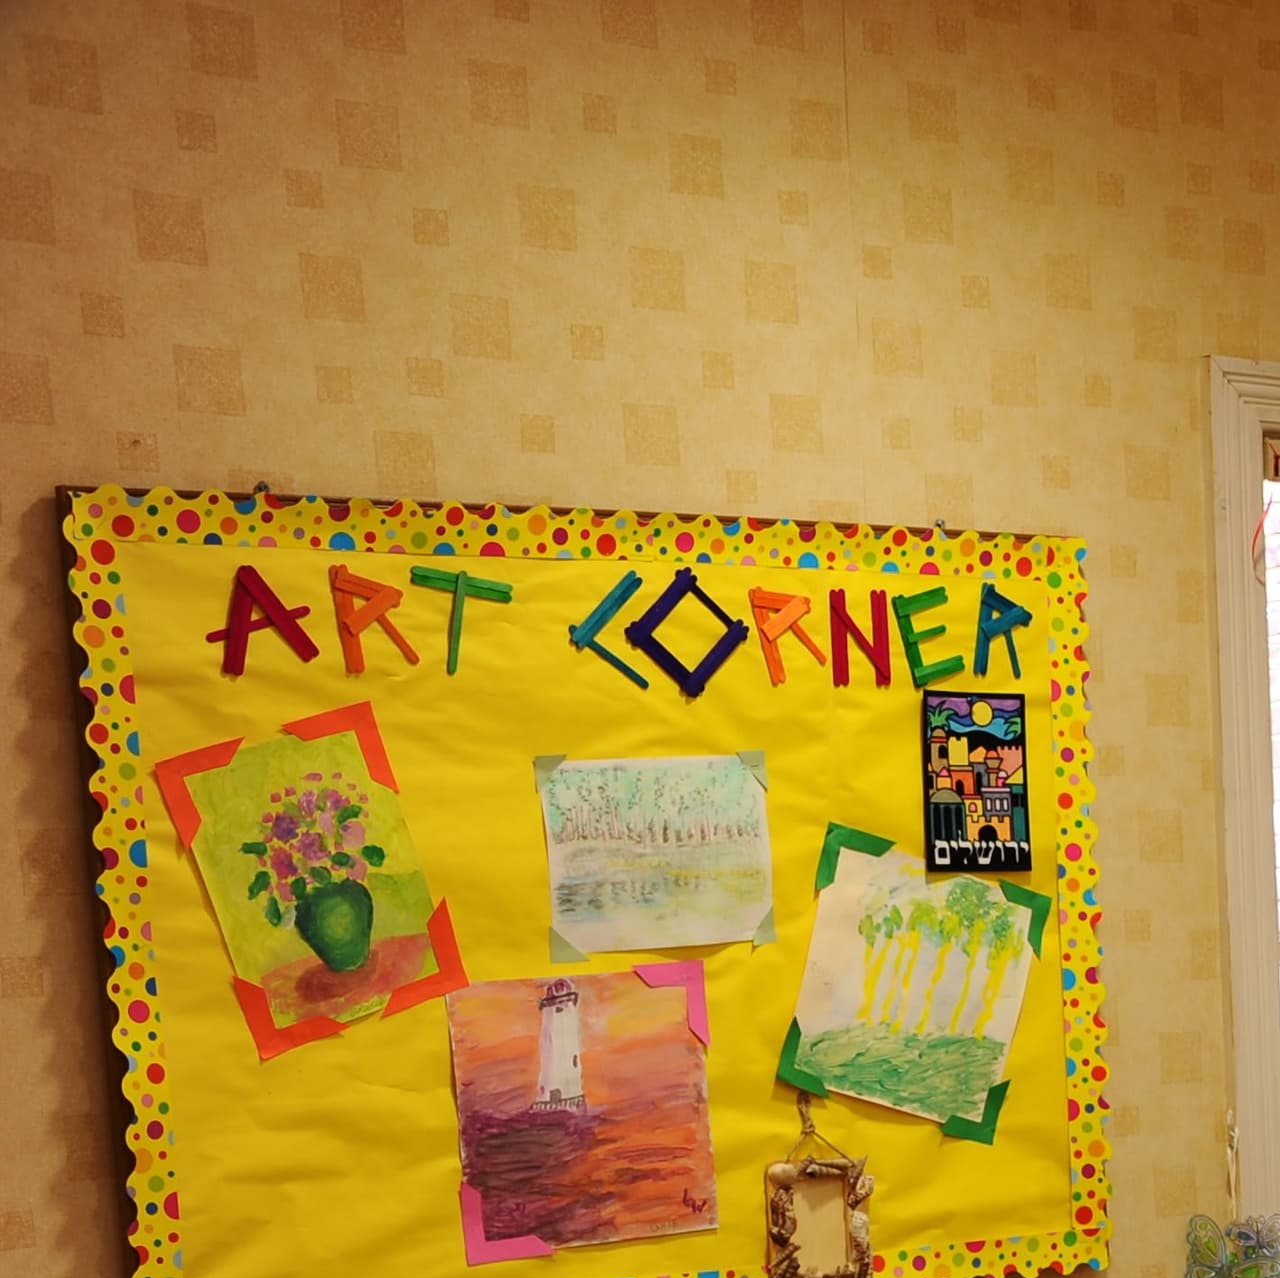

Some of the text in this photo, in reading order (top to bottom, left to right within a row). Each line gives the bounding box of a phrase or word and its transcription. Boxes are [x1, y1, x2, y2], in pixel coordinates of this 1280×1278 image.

[206, 564, 1033, 697] ART CORNER
[934, 829, 1029, 865] ירושלים
